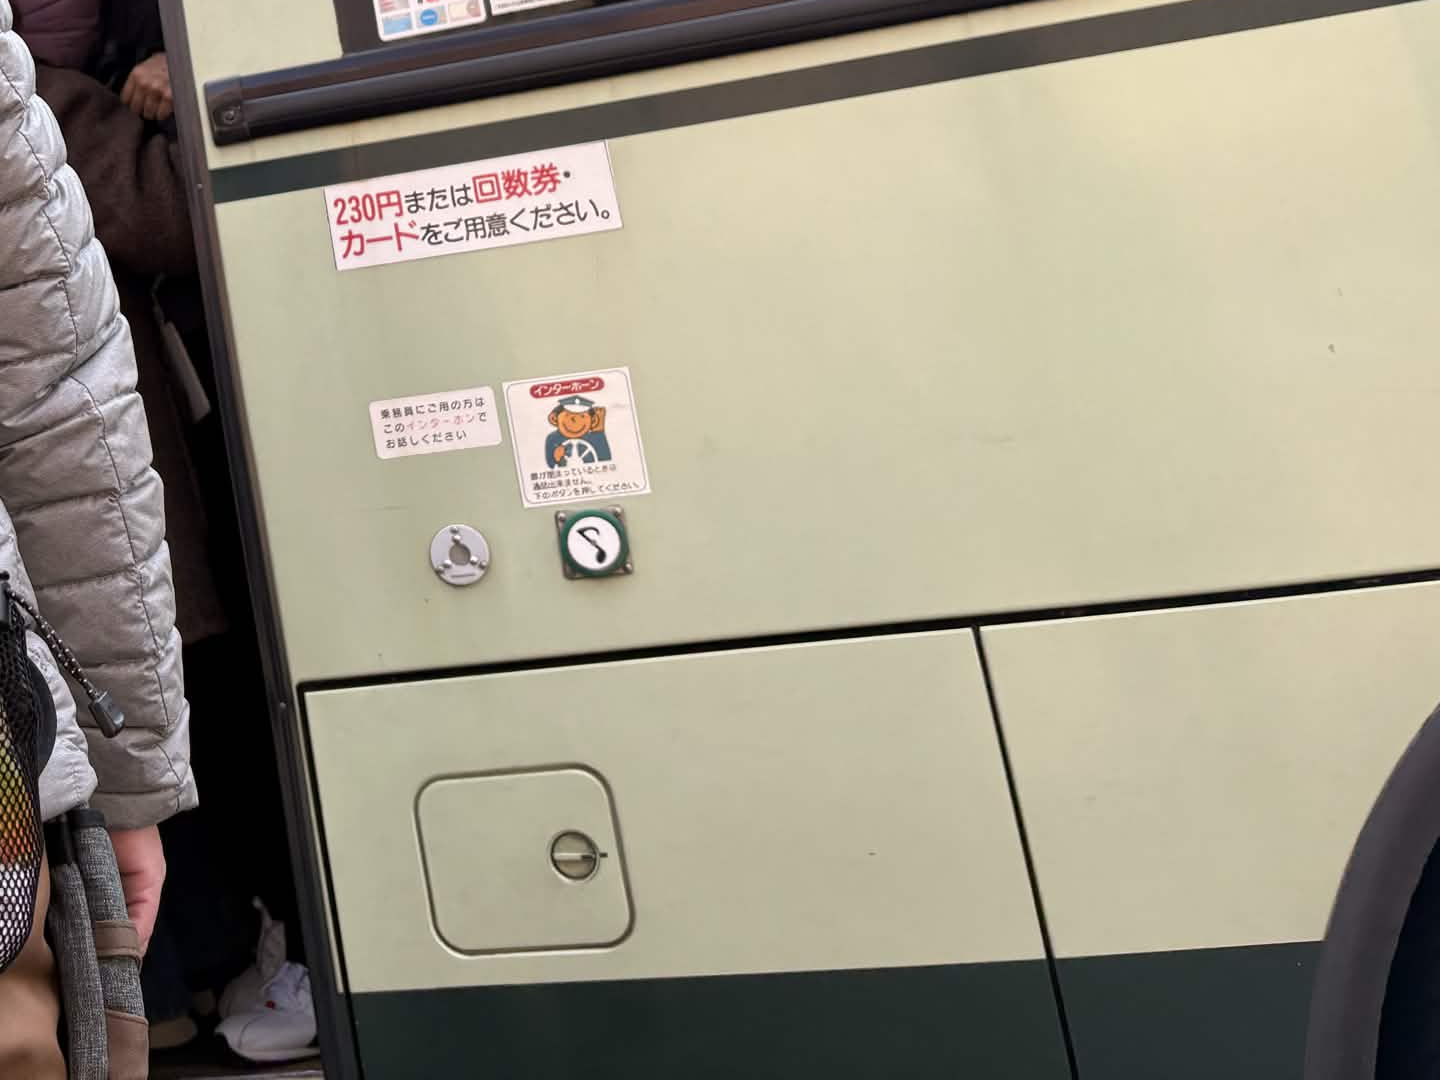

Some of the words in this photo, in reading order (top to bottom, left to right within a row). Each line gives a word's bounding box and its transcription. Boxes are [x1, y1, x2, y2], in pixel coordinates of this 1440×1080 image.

[340, 199, 611, 259] カードをご用意ください。
[533, 379, 601, 396] インターホーン
[380, 397, 485, 420] 乗務員にご用の方は
[385, 430, 467, 449] お話しください
